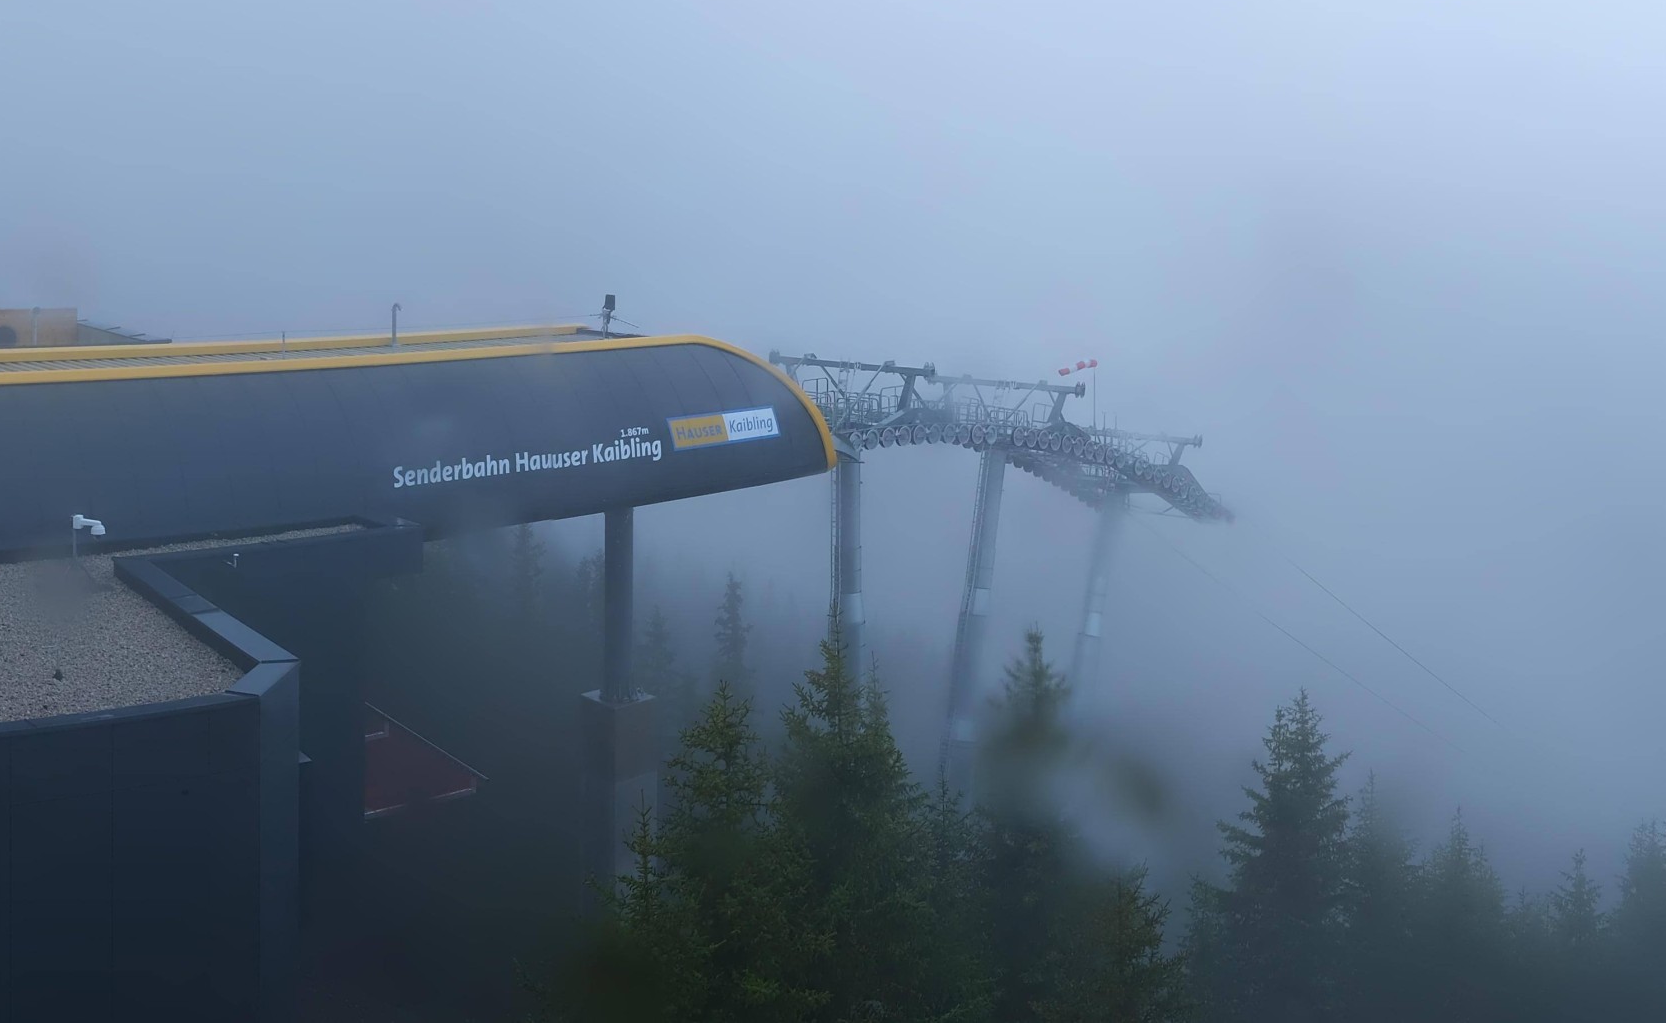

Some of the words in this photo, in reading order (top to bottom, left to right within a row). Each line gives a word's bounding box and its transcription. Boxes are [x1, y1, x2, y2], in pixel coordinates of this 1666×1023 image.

[620, 427, 649, 438] 1.867m
[675, 424, 723, 441] HAUSER
[729, 416, 773, 433] Kaibling
[393, 454, 510, 488] Senderbahn
[592, 437, 662, 463] Kaibling
